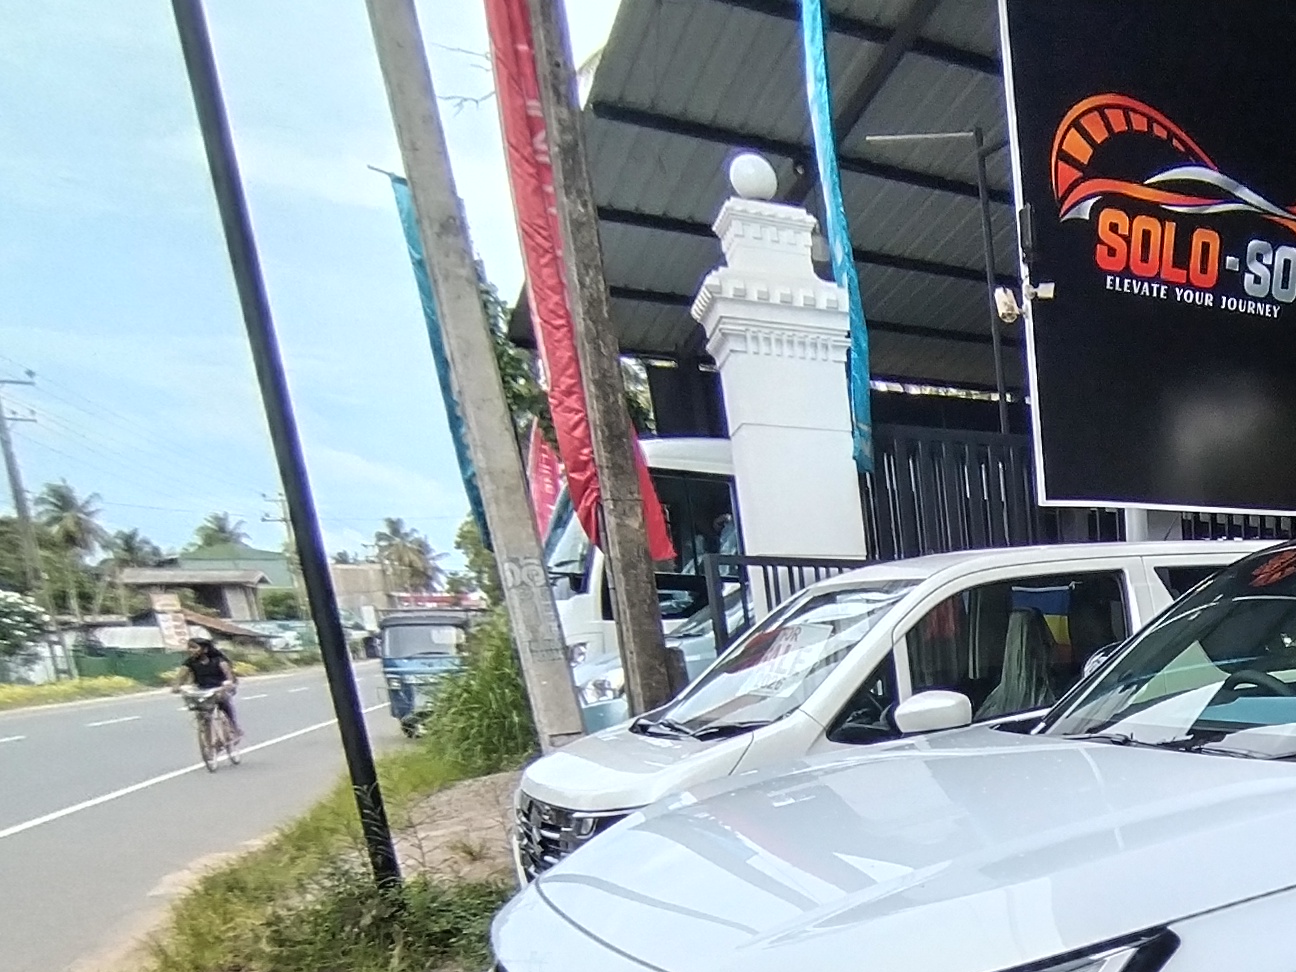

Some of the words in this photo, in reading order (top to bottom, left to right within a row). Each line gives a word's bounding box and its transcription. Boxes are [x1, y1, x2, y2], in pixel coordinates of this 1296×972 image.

[1106, 275, 1168, 299] ELEVATE
[1175, 287, 1213, 306] YOUR
[1220, 296, 1281, 318] JOURNEY
